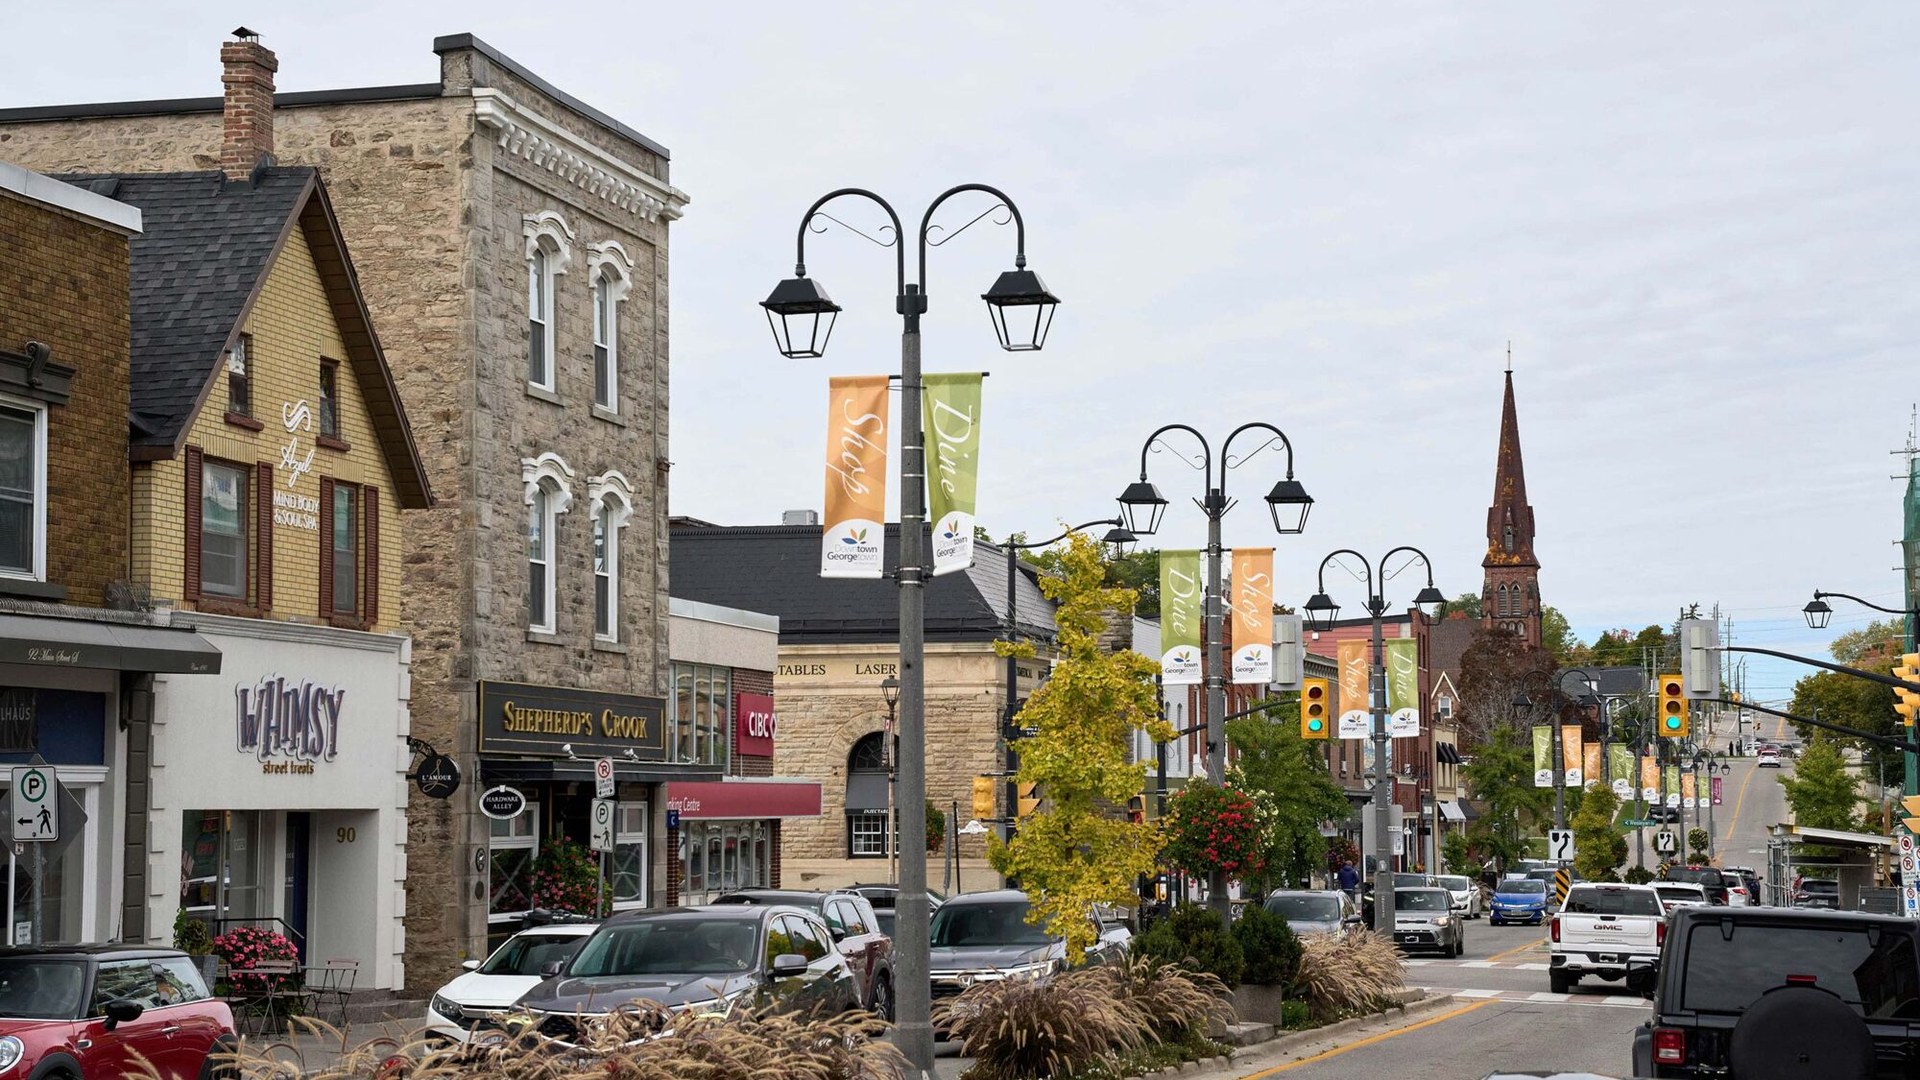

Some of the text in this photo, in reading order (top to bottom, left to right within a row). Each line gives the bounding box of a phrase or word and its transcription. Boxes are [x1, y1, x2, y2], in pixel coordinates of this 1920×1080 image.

[279, 437, 314, 488] Azul
[826, 398, 887, 502] Shop
[933, 399, 973, 499] Dine
[1168, 567, 1195, 637] Dine
[1231, 563, 1273, 633] Shop
[855, 664, 898, 675] LASER
[1392, 652, 1413, 701] Dine
[239, 677, 346, 758] WHIMSY
[504, 701, 648, 739] SHEPHERD'S CROOK
[749, 711, 769, 738] CIBC
[29, 778, 40, 795] P
[262, 761, 315, 775] street treats
[683, 797, 700, 811] Centre
[336, 826, 356, 844] 90
